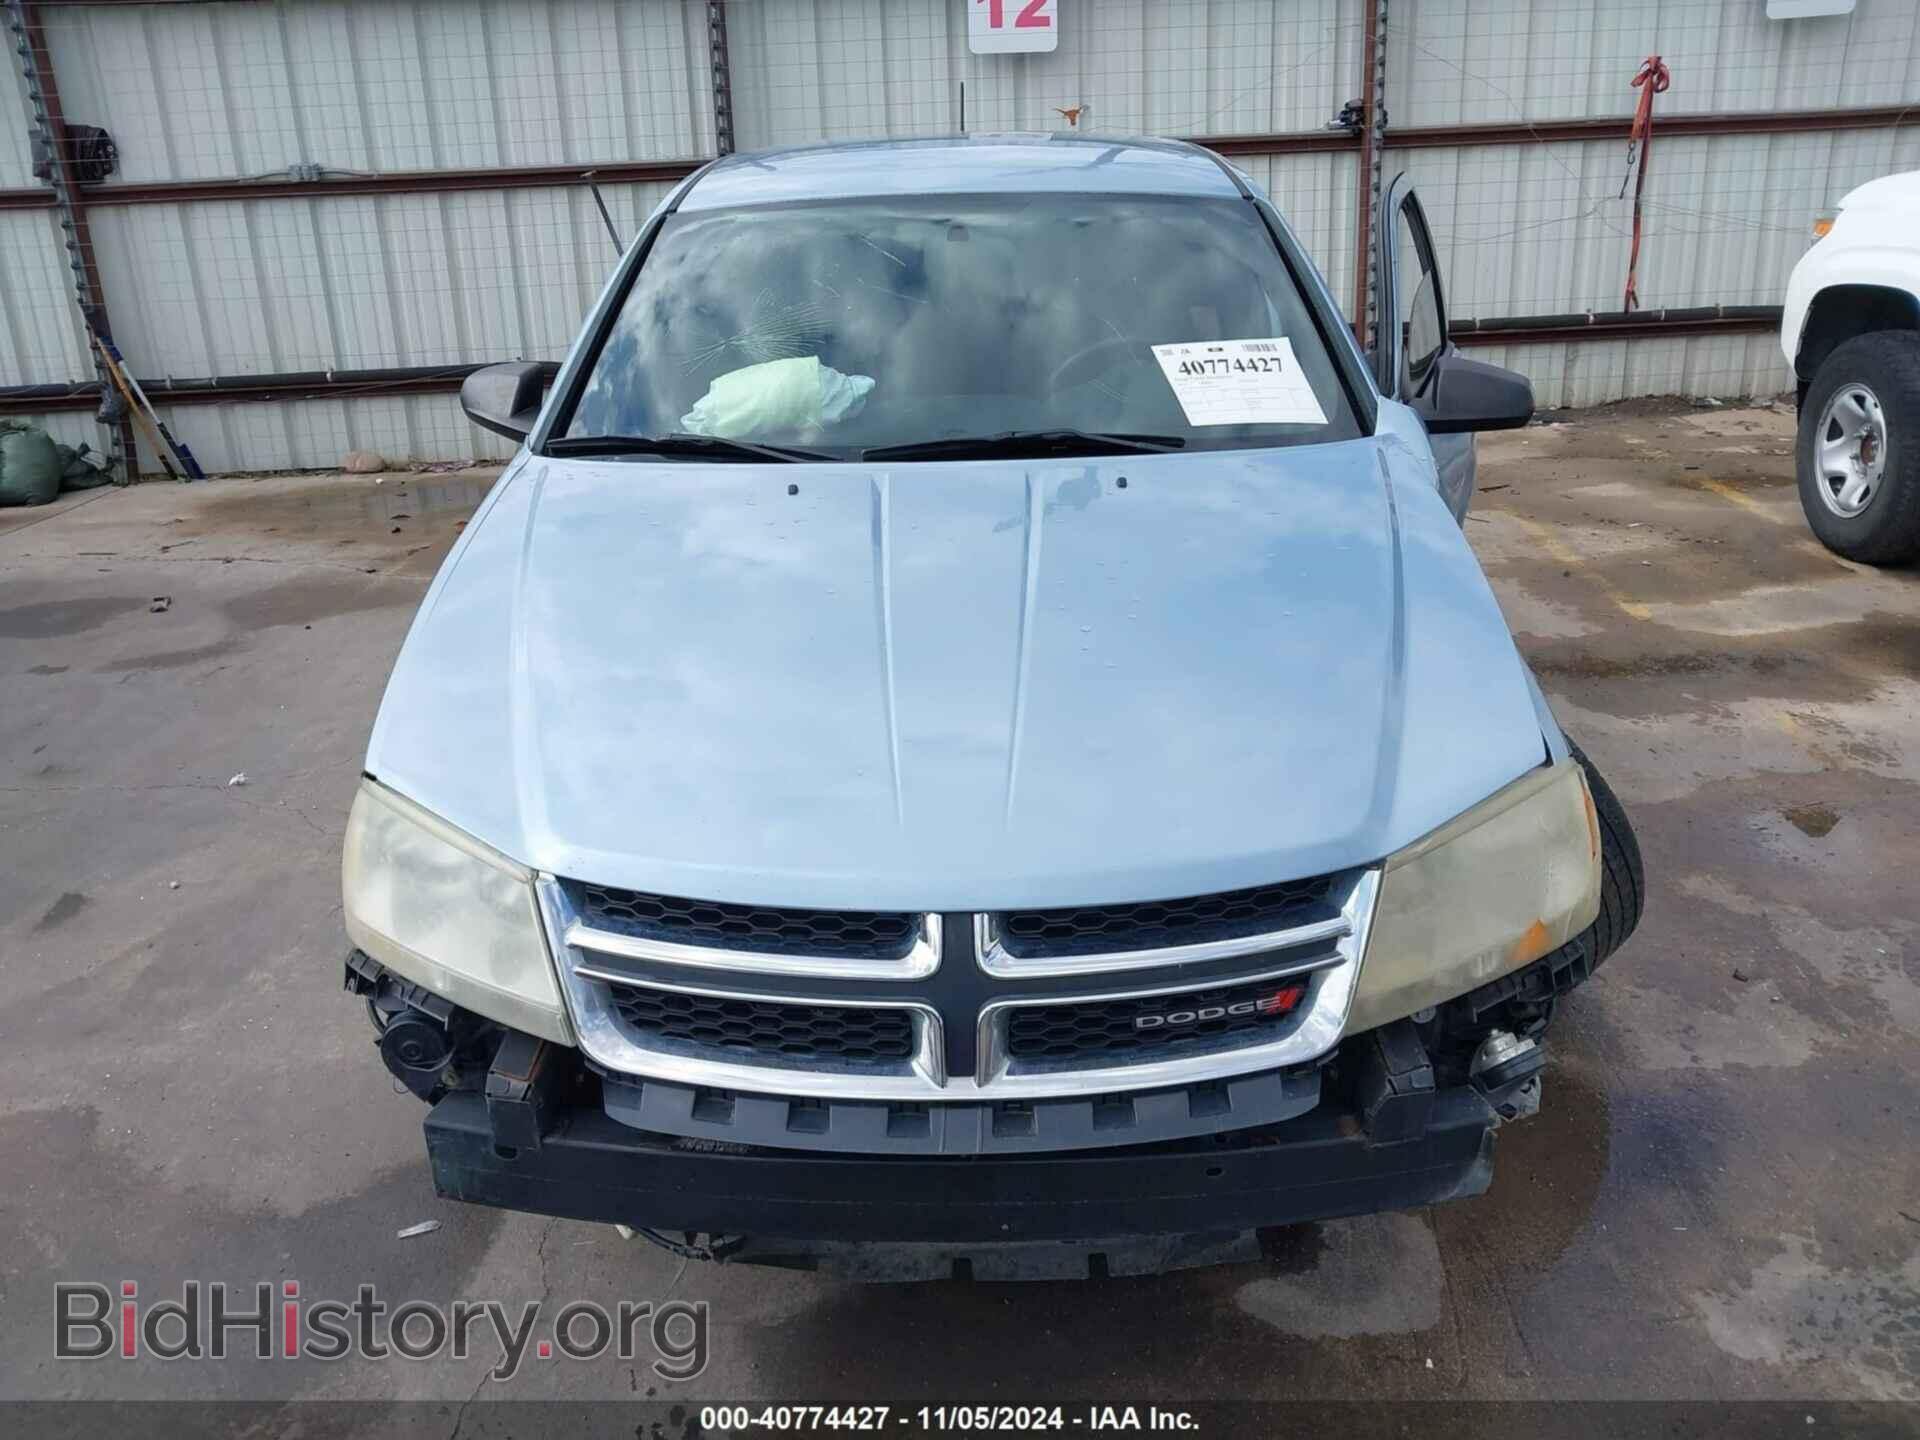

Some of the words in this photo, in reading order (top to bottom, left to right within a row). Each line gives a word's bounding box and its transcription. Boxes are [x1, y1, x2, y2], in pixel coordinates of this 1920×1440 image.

[977, 0, 1051, 29] 12
[1178, 357, 1283, 376] 40774427
[1135, 996, 1281, 1028] DODGE
